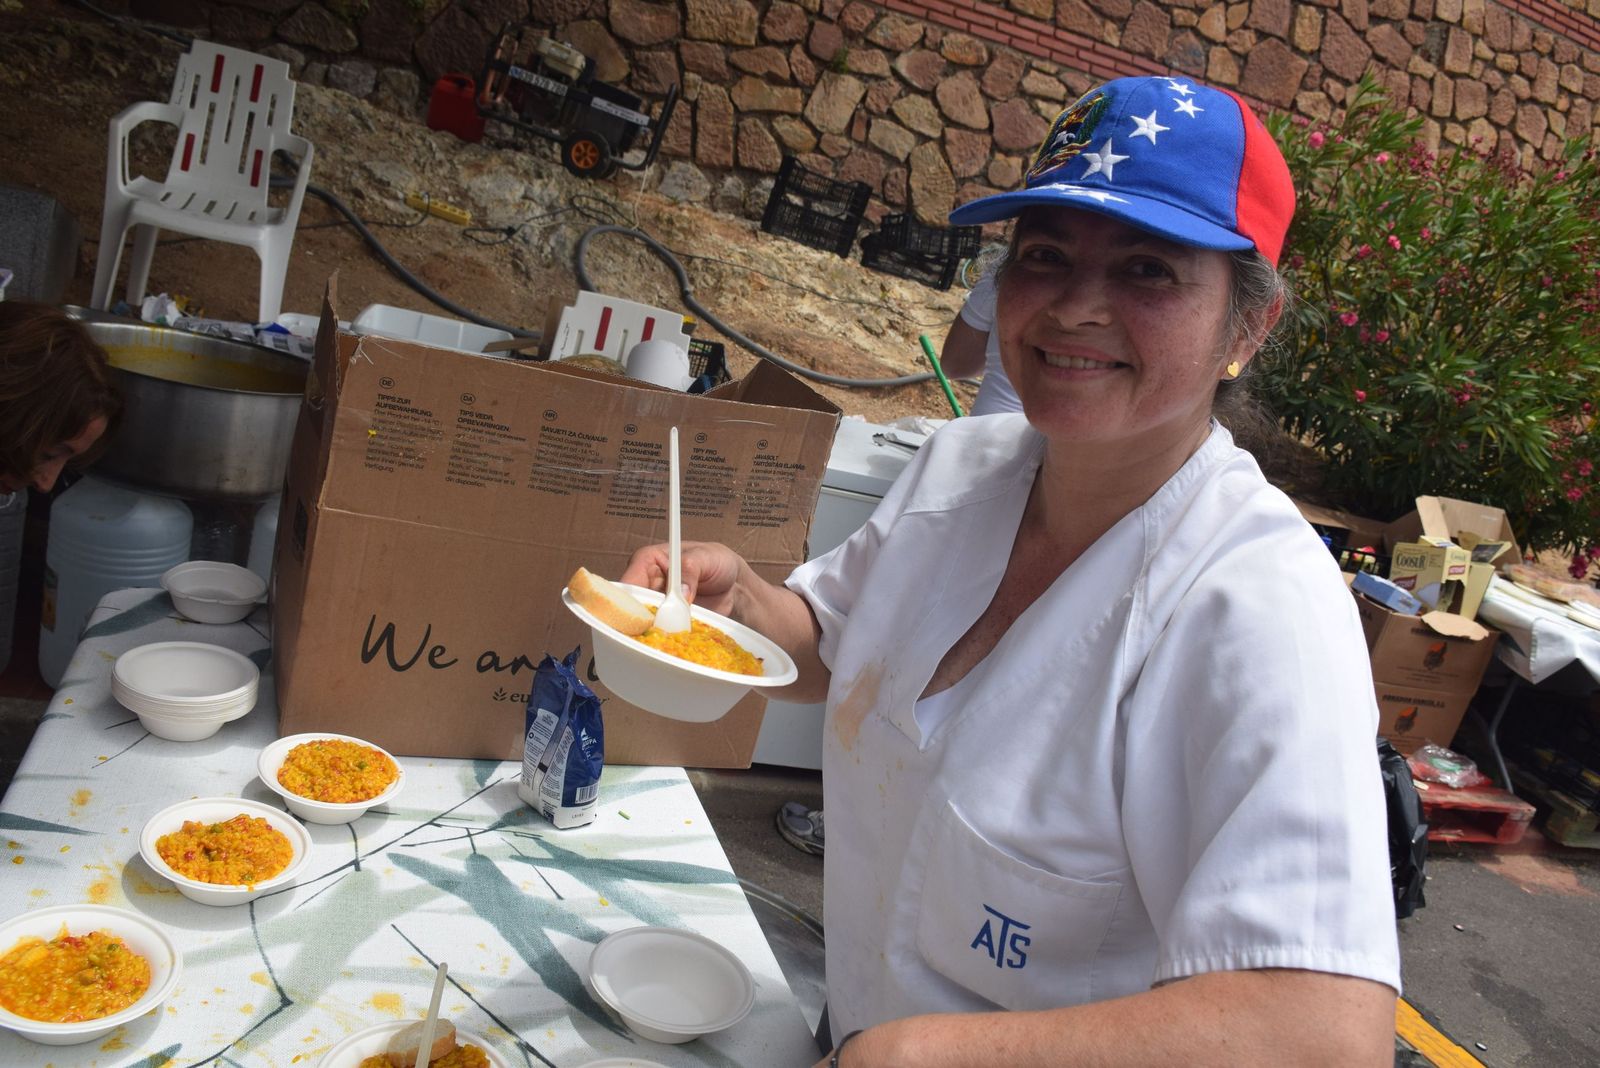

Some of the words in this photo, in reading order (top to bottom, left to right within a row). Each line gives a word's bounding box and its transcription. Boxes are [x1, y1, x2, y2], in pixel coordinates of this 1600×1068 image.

[377, 393, 396, 402] TIPPS
[397, 397, 411, 405] ZUR
[459, 409, 474, 417] TIPS
[541, 426, 567, 436] SAVJETI
[360, 614, 459, 672] We
[970, 903, 1031, 968] ATS
